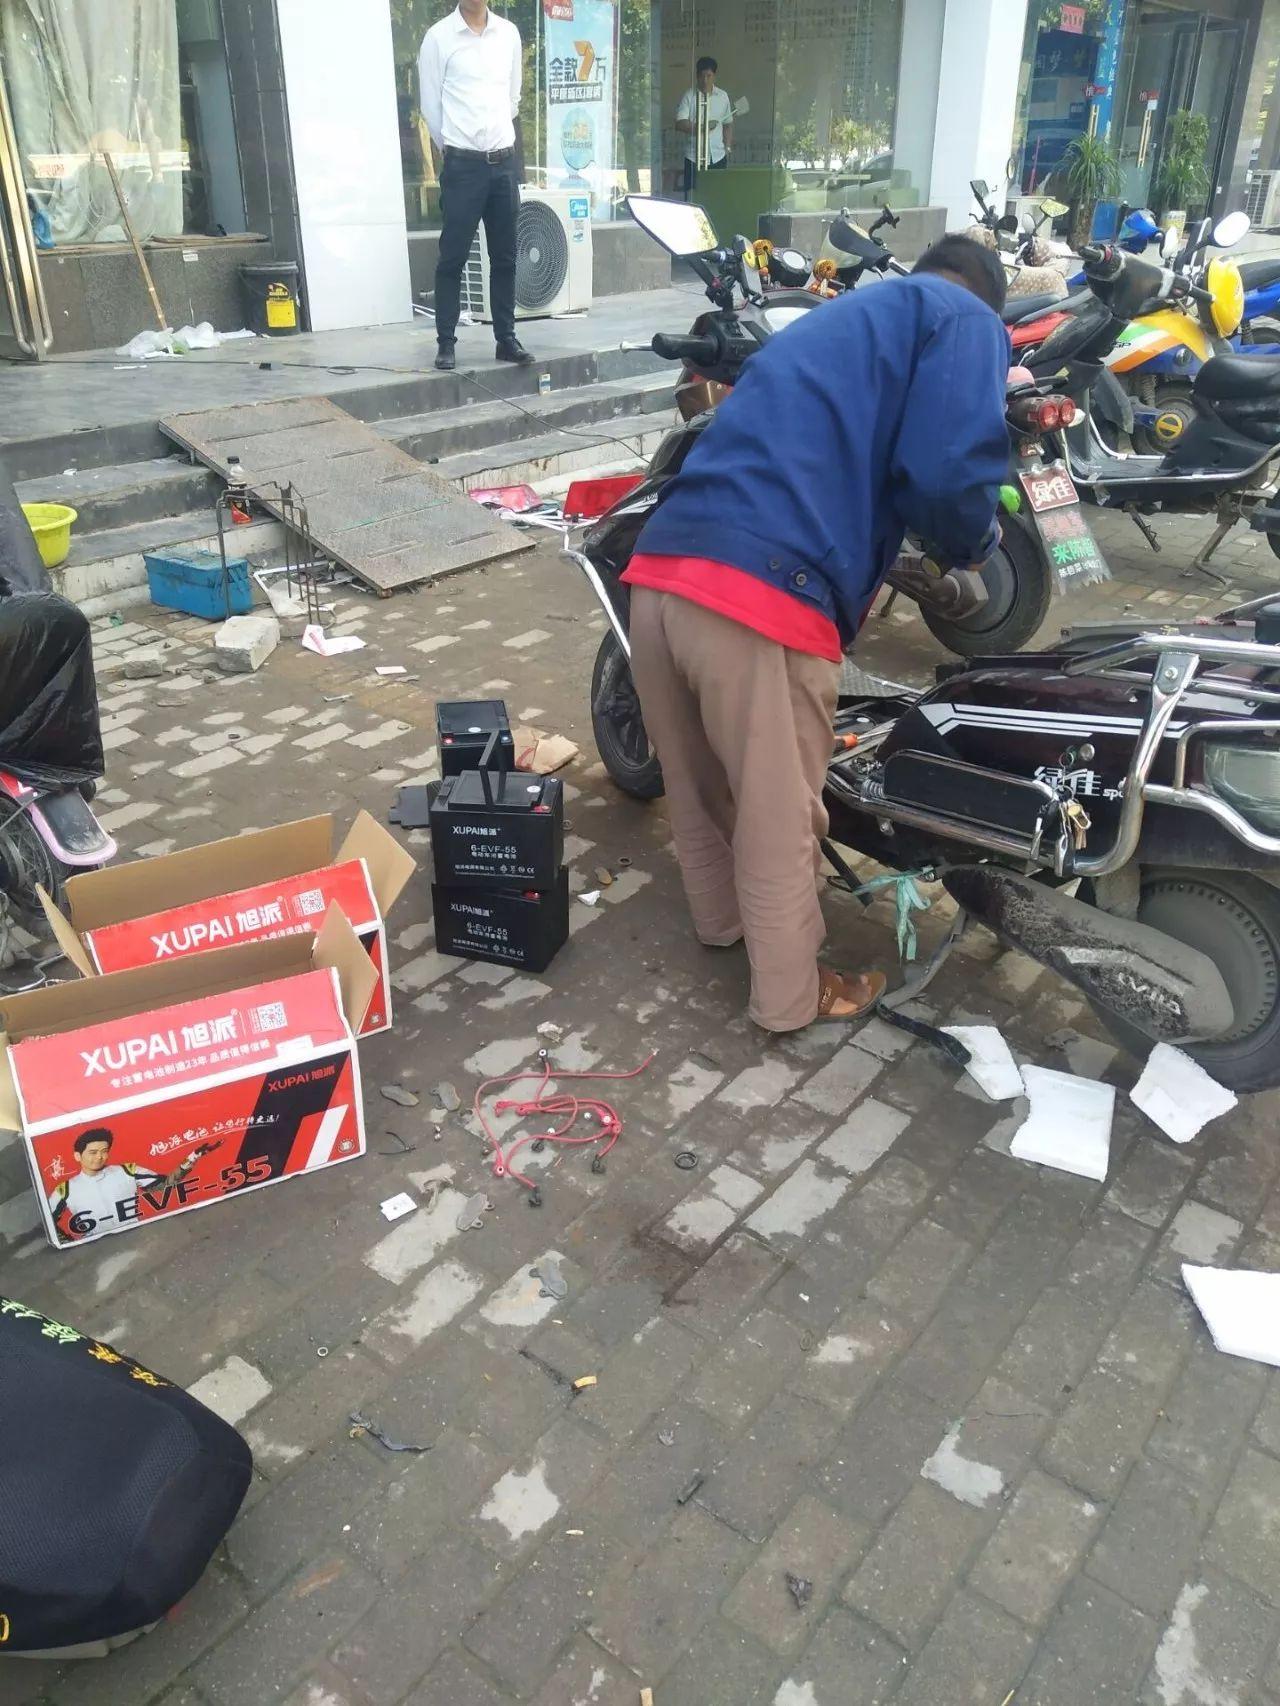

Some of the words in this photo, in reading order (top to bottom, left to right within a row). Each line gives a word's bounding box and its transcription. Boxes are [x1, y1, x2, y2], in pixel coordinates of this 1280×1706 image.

[471, 844, 517, 854] 6-EVF-55
[150, 916, 233, 958] XUPAI
[237, 901, 283, 933] 旭派
[80, 1029, 179, 1077] XUPAI
[181, 1015, 238, 1051] 旭派
[268, 1073, 309, 1092] XUPAI
[311, 1065, 335, 1080] 旭派
[68, 1155, 272, 1236] 6-EVF-55
